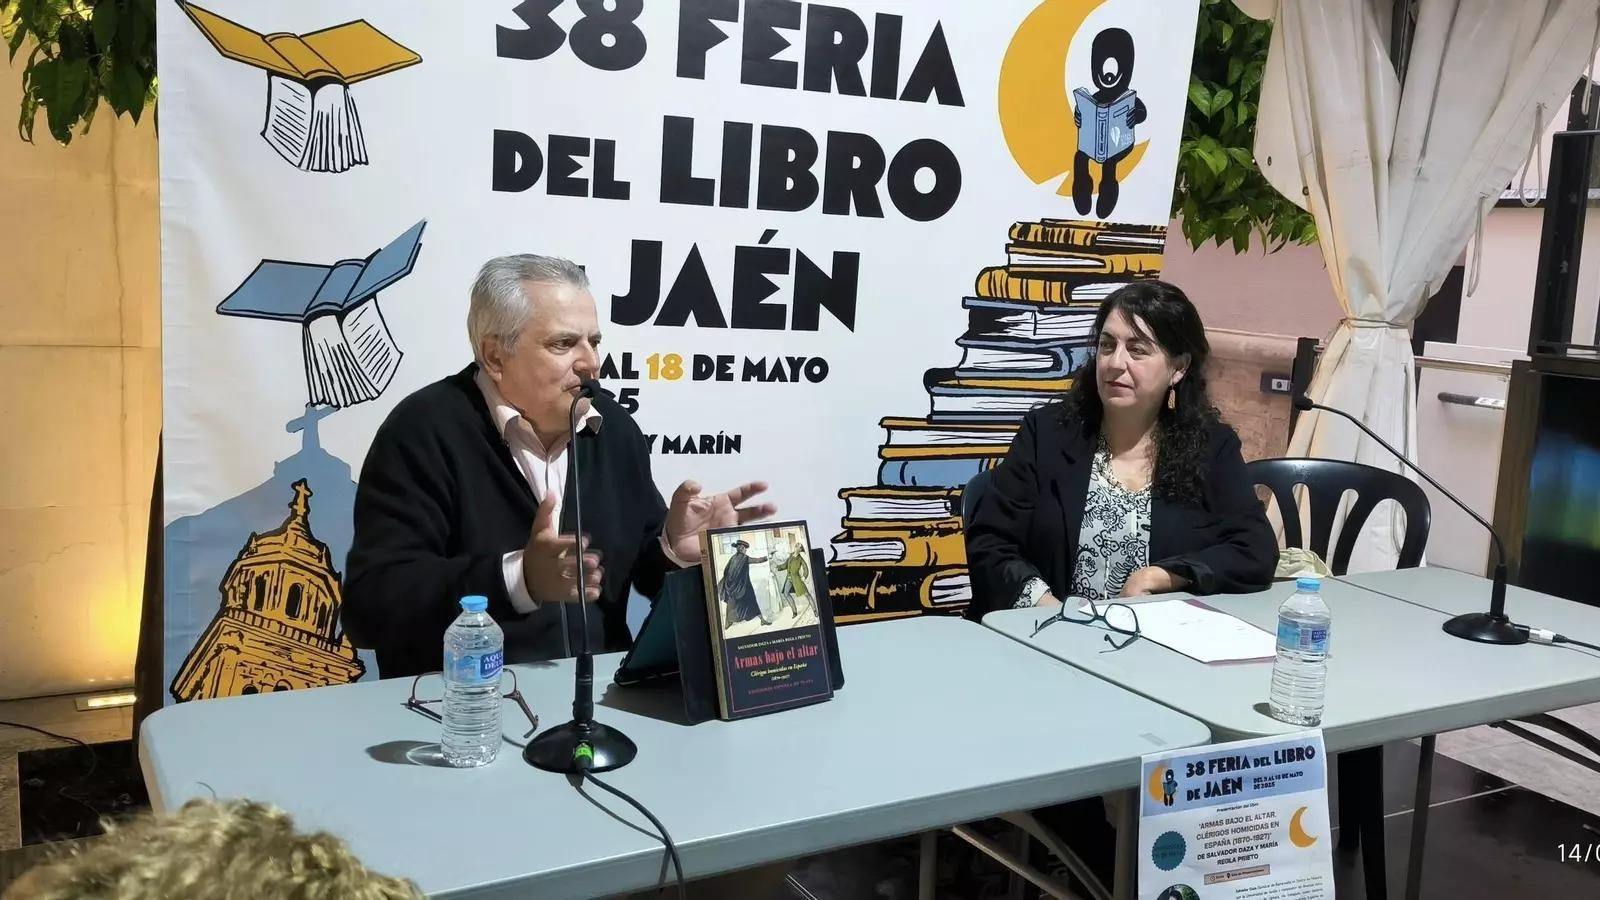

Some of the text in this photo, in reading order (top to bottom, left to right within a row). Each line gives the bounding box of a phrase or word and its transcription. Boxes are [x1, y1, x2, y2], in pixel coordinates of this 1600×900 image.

[496, 0, 966, 107] 38 FERIA
[492, 115, 962, 222] DEL LIBRO
[610, 229, 860, 333] JAÉN
[600, 352, 829, 384] AL 18 DE MAYO
[661, 430, 742, 454] MARÍN
[734, 644, 818, 669] Armas bajo el altar
[1186, 745, 1316, 778] 38 FERIA DEL LIBRO
[1186, 776, 1243, 802] DE JAÉN
[1196, 820, 1280, 841] CLÉRIGOS HOMICIDAS EN
[1225, 816, 1244, 826] BAJO
[1245, 814, 1253, 823] EL
[1197, 853, 1205, 861] DE
[1206, 848, 1238, 859] SALVADOR
[1238, 845, 1254, 854] DAZA
[1259, 840, 1279, 849] MARÍA
[1204, 838, 1231, 850] ESPAÑA
[1217, 853, 1259, 866] REGLA PRIETO
